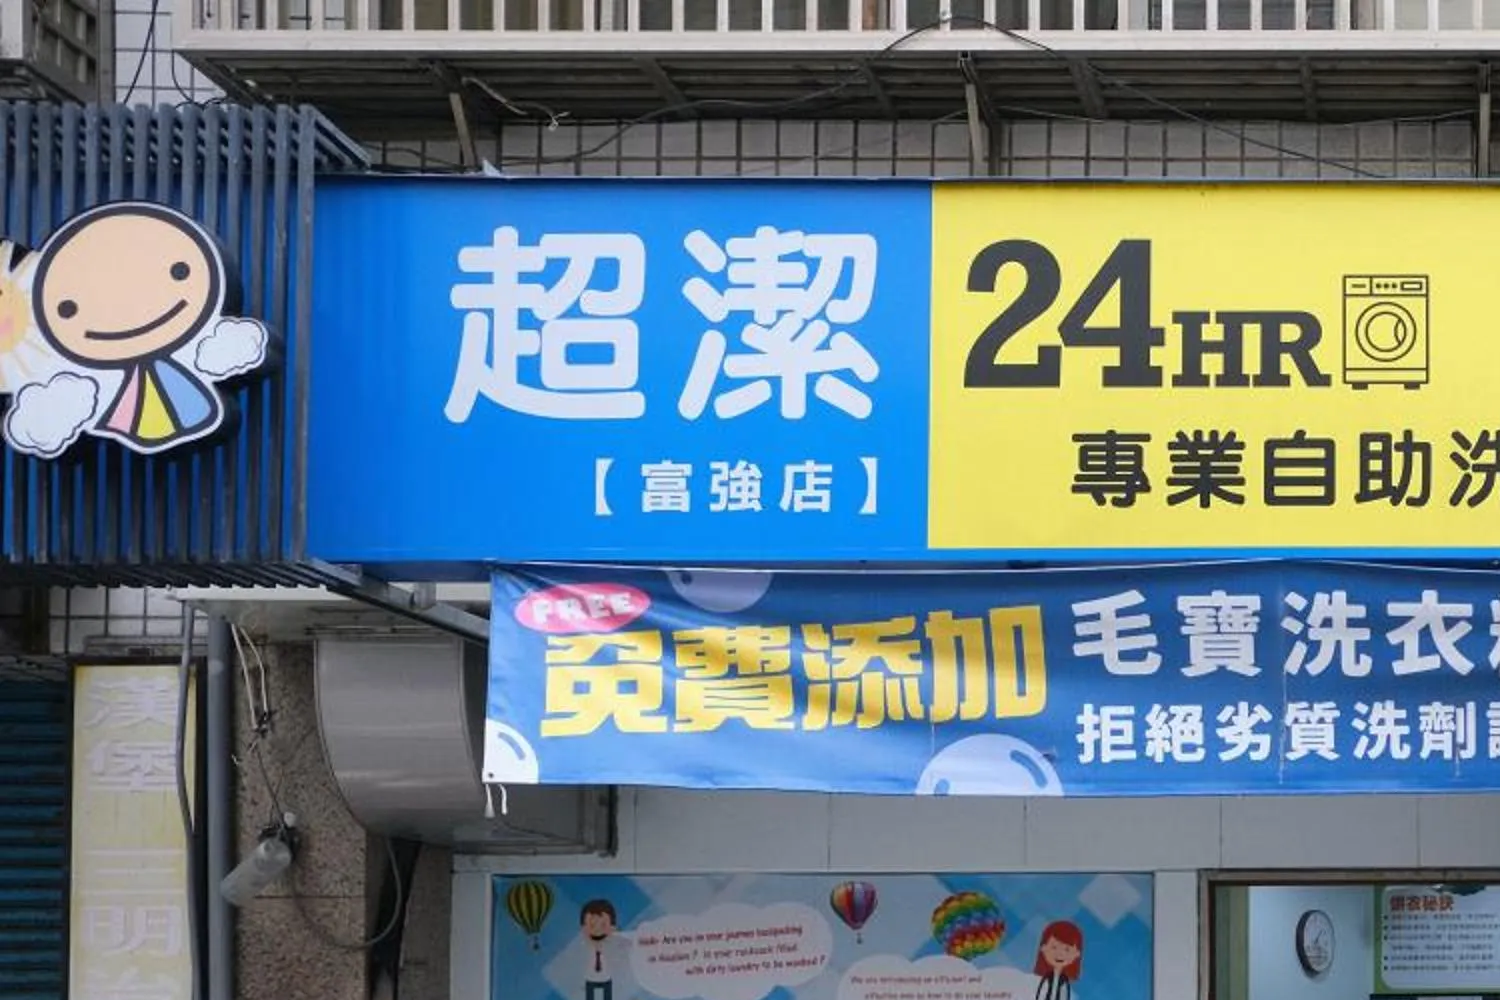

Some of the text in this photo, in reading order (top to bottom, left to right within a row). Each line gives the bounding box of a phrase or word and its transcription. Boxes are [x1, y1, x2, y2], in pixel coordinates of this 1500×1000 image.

[444, 225, 879, 424] 超潔
[963, 238, 1332, 388] 24HR
[594, 456, 877, 515] 【富強店】
[531, 591, 638, 625] FREE
[540, 604, 1048, 738] 免費添加
